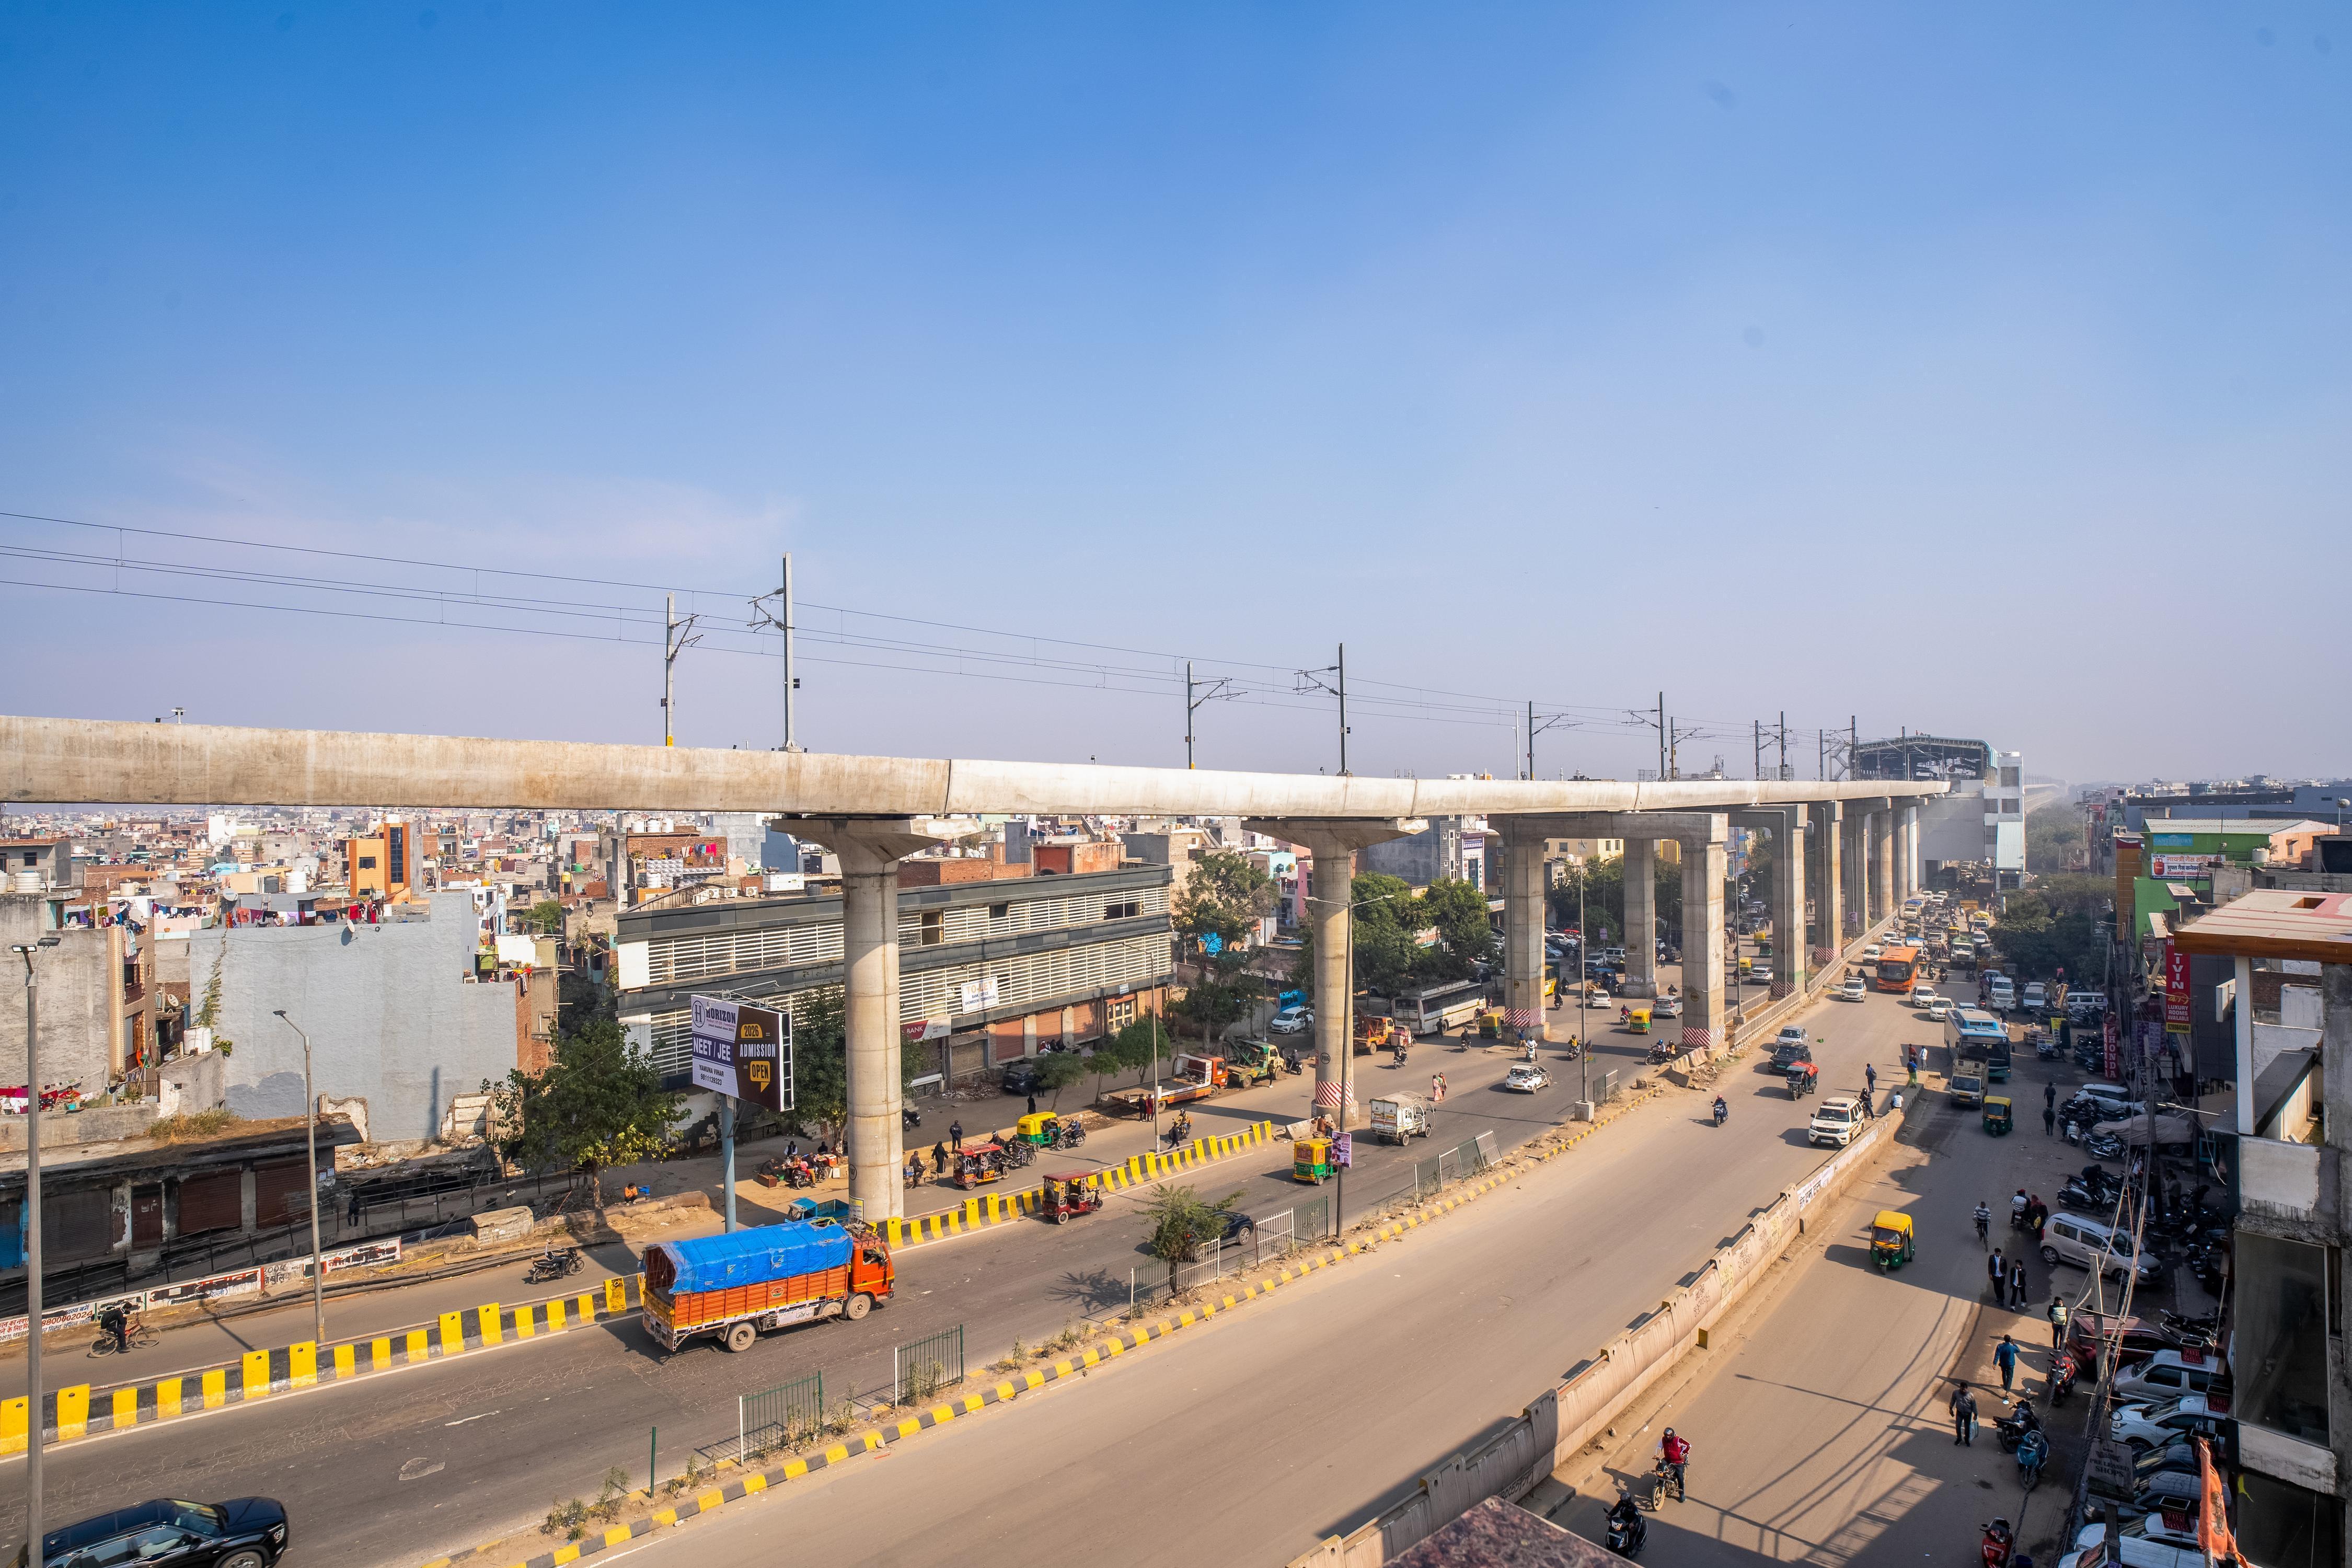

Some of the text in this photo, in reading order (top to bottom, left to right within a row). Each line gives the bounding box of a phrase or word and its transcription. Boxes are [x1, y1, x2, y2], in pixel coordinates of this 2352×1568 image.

[2172, 953, 2184, 989] IVIN
[705, 1008, 736, 1024] HORIZON
[744, 1025, 759, 1037] 2026
[906, 1025, 924, 1034] BANK
[693, 1036, 712, 1056] NEET
[717, 1043, 731, 1062] JEE
[740, 1043, 776, 1057] ADMISSION
[699, 1064, 724, 1077] YAMUNA VIHAR
[752, 1064, 769, 1079] OPEN
[2095, 1466, 2125, 1478] SHOPS
